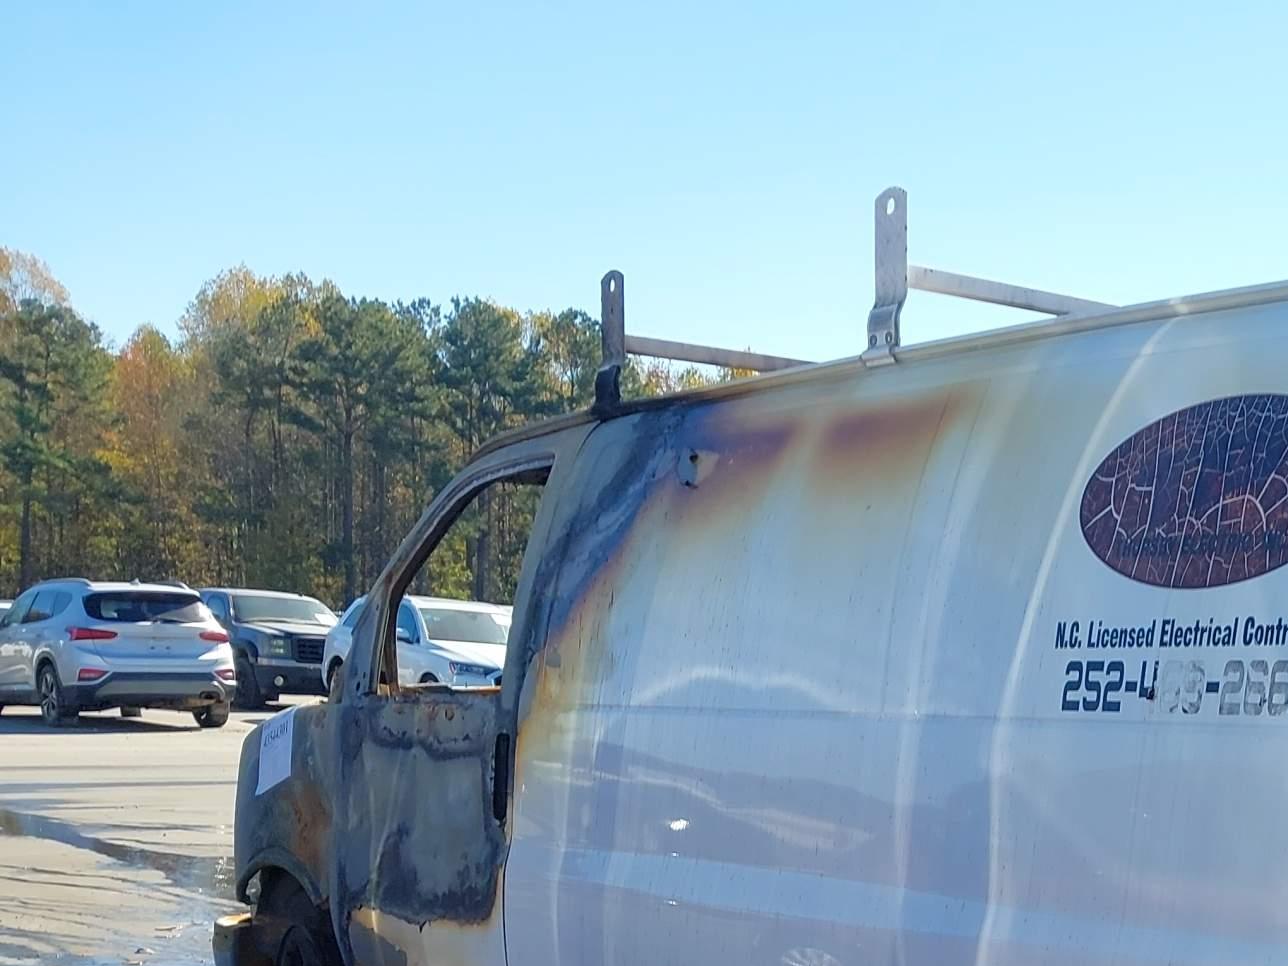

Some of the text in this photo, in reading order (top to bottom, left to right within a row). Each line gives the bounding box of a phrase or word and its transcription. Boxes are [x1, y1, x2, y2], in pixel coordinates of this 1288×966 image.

[1055, 621, 1082, 649] N.C.
[1087, 619, 1155, 649] Licensed
[1159, 617, 1239, 649] Electrical
